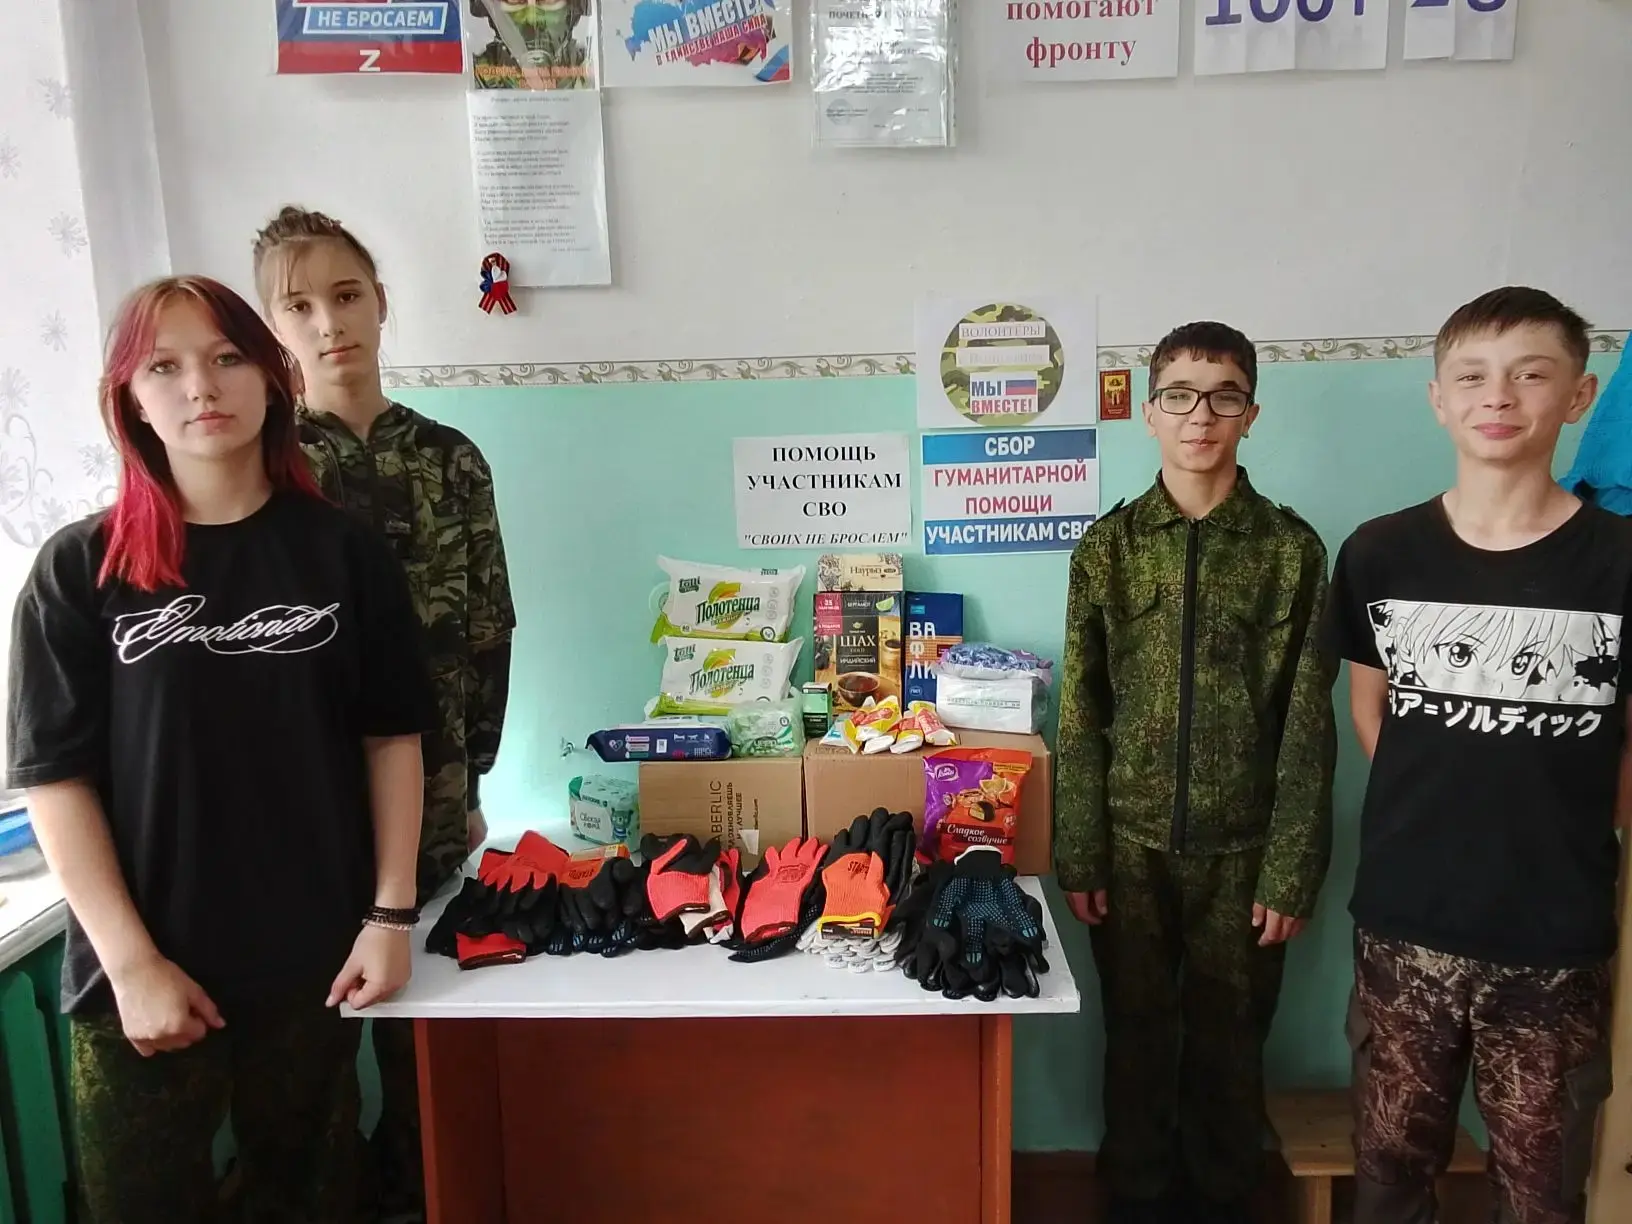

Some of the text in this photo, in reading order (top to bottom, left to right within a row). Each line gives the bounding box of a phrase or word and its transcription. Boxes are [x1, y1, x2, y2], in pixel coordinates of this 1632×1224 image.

[318, 10, 434, 27] НЕ БРОСАЕМ
[1006, 0, 1157, 20] помогают
[648, 19, 684, 52] МЫ
[655, 13, 768, 66] В ЕДИНСТВЕ НАША СИЛА
[358, 49, 381, 72] Z
[1026, 36, 1137, 68] фронту
[971, 380, 1002, 397] МЫ
[971, 398, 1033, 414] ВМЕСТЕ!
[772, 446, 876, 464] ПОМОЩЬ
[985, 435, 1035, 456] СБОР
[746, 473, 901, 490] УЧАСТНИКАМ
[934, 457, 1087, 487] ГУМАНИТАРНОЙ
[802, 501, 847, 517] СВО
[965, 494, 1052, 515] ПОМОЩИ
[744, 532, 908, 546] "СВОИХ НЕ БРОСАЕМ"
[926, 522, 1054, 545] УЧАСТНИКАМ
[695, 596, 761, 625] Полотенца
[909, 621, 936, 640] ВА
[840, 635, 876, 647] ШАХ
[688, 663, 755, 695] Полотенца
[709, 780, 723, 842] ABERLIC
[947, 824, 985, 838] Сладкое
[967, 834, 1008, 845] созвучие
